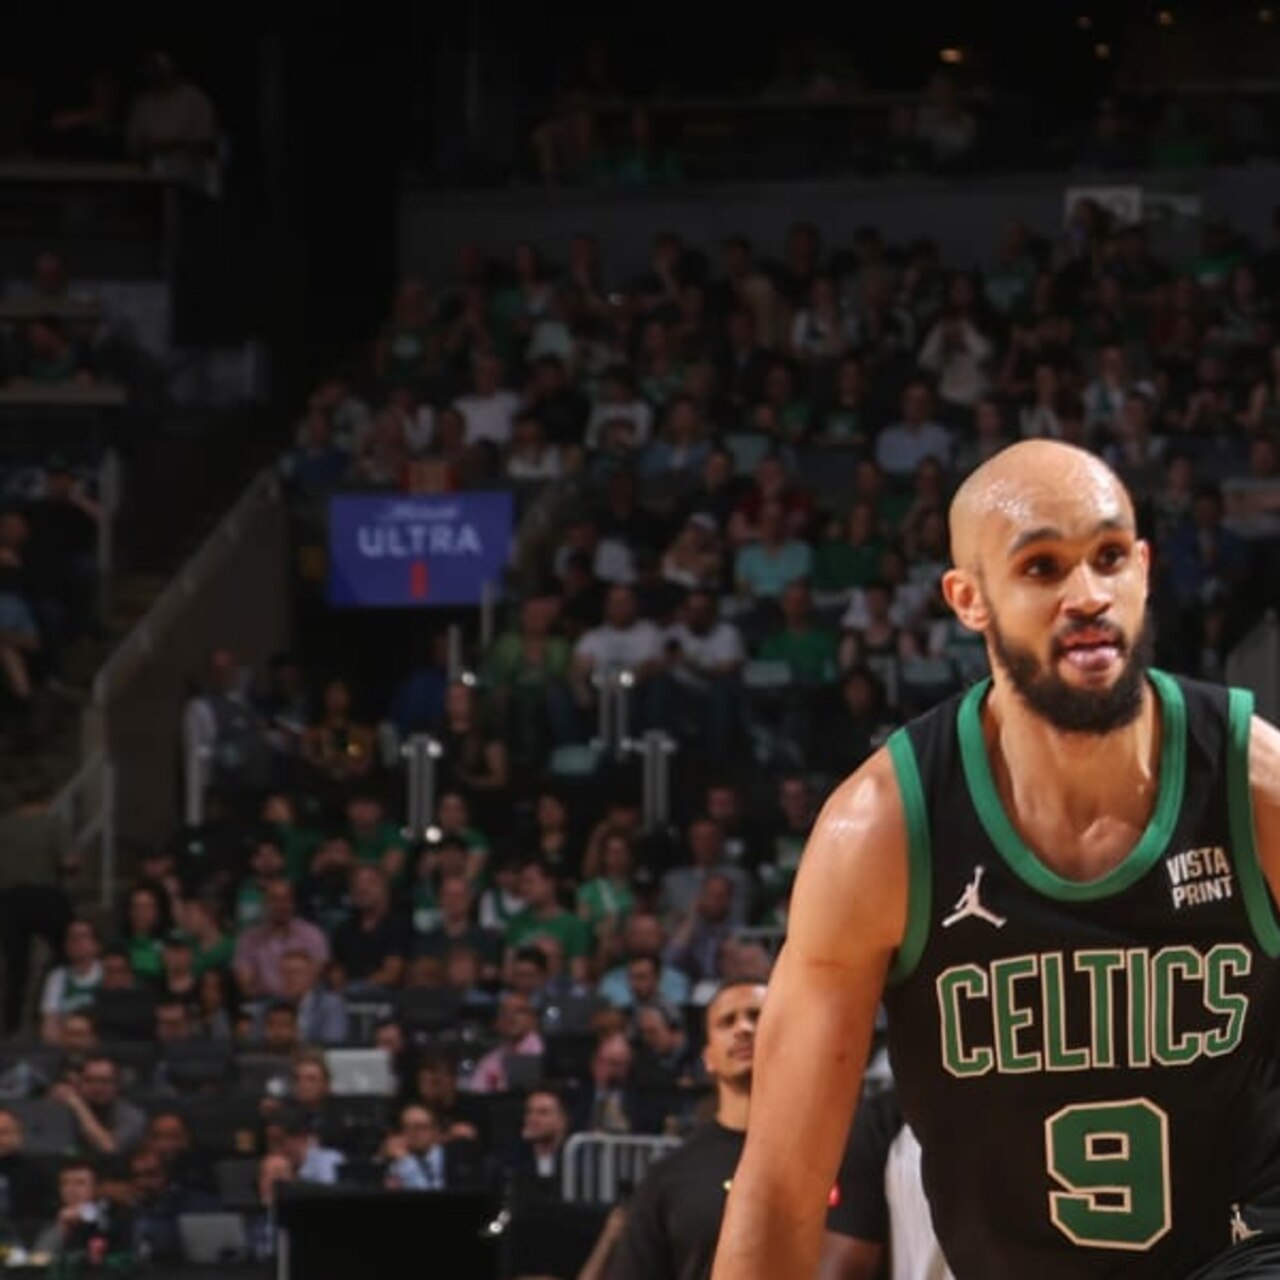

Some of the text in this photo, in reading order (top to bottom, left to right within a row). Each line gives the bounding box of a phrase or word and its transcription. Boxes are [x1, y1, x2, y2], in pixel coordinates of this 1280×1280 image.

[356, 522, 483, 560] ULTRA
[1165, 844, 1231, 886] VISTA
[1171, 875, 1234, 911] PRINT
[935, 942, 1253, 1079] CELTICS
[1044, 1096, 1173, 1252] 9
